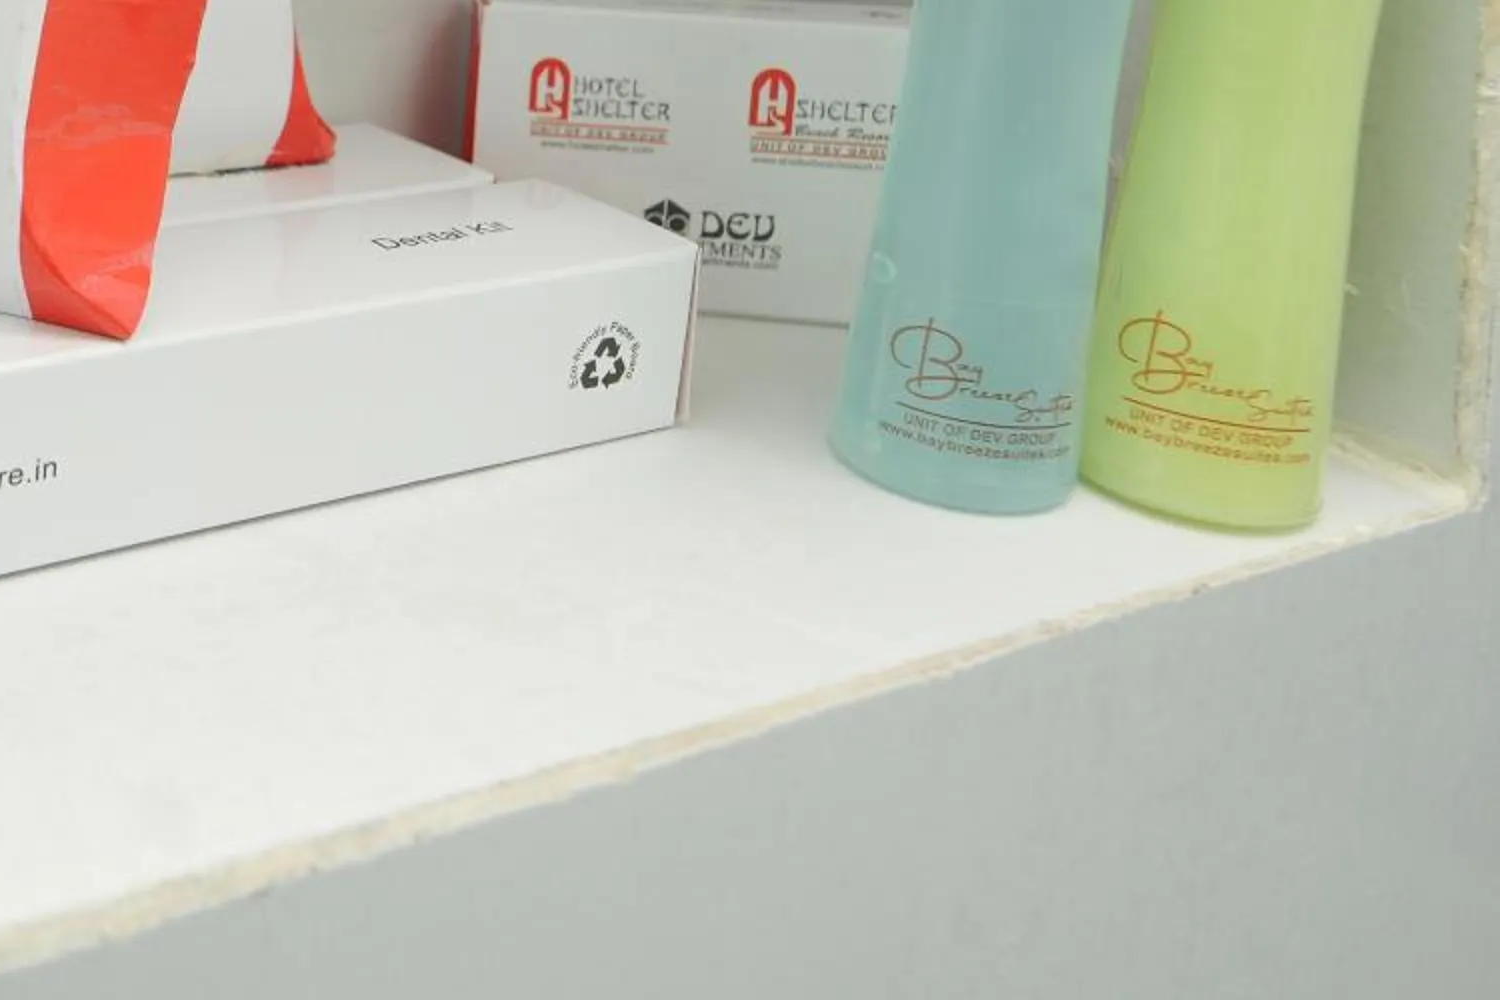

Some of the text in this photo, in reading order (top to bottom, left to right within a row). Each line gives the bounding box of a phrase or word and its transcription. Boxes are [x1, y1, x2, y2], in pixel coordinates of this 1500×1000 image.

[574, 75, 647, 98] HOTEL
[572, 98, 670, 121] SHELTER
[371, 219, 514, 251] Dental Kit
[701, 211, 775, 241] DEV
[890, 317, 984, 400] Bay
[1118, 310, 1215, 394] Bay
[904, 412, 940, 432] UNIT
[944, 422, 967, 437] OF
[970, 428, 1002, 446] DEV
[1129, 407, 1166, 427] UNIT
[1169, 418, 1194, 434] OF
[1198, 425, 1236, 443] DEV
